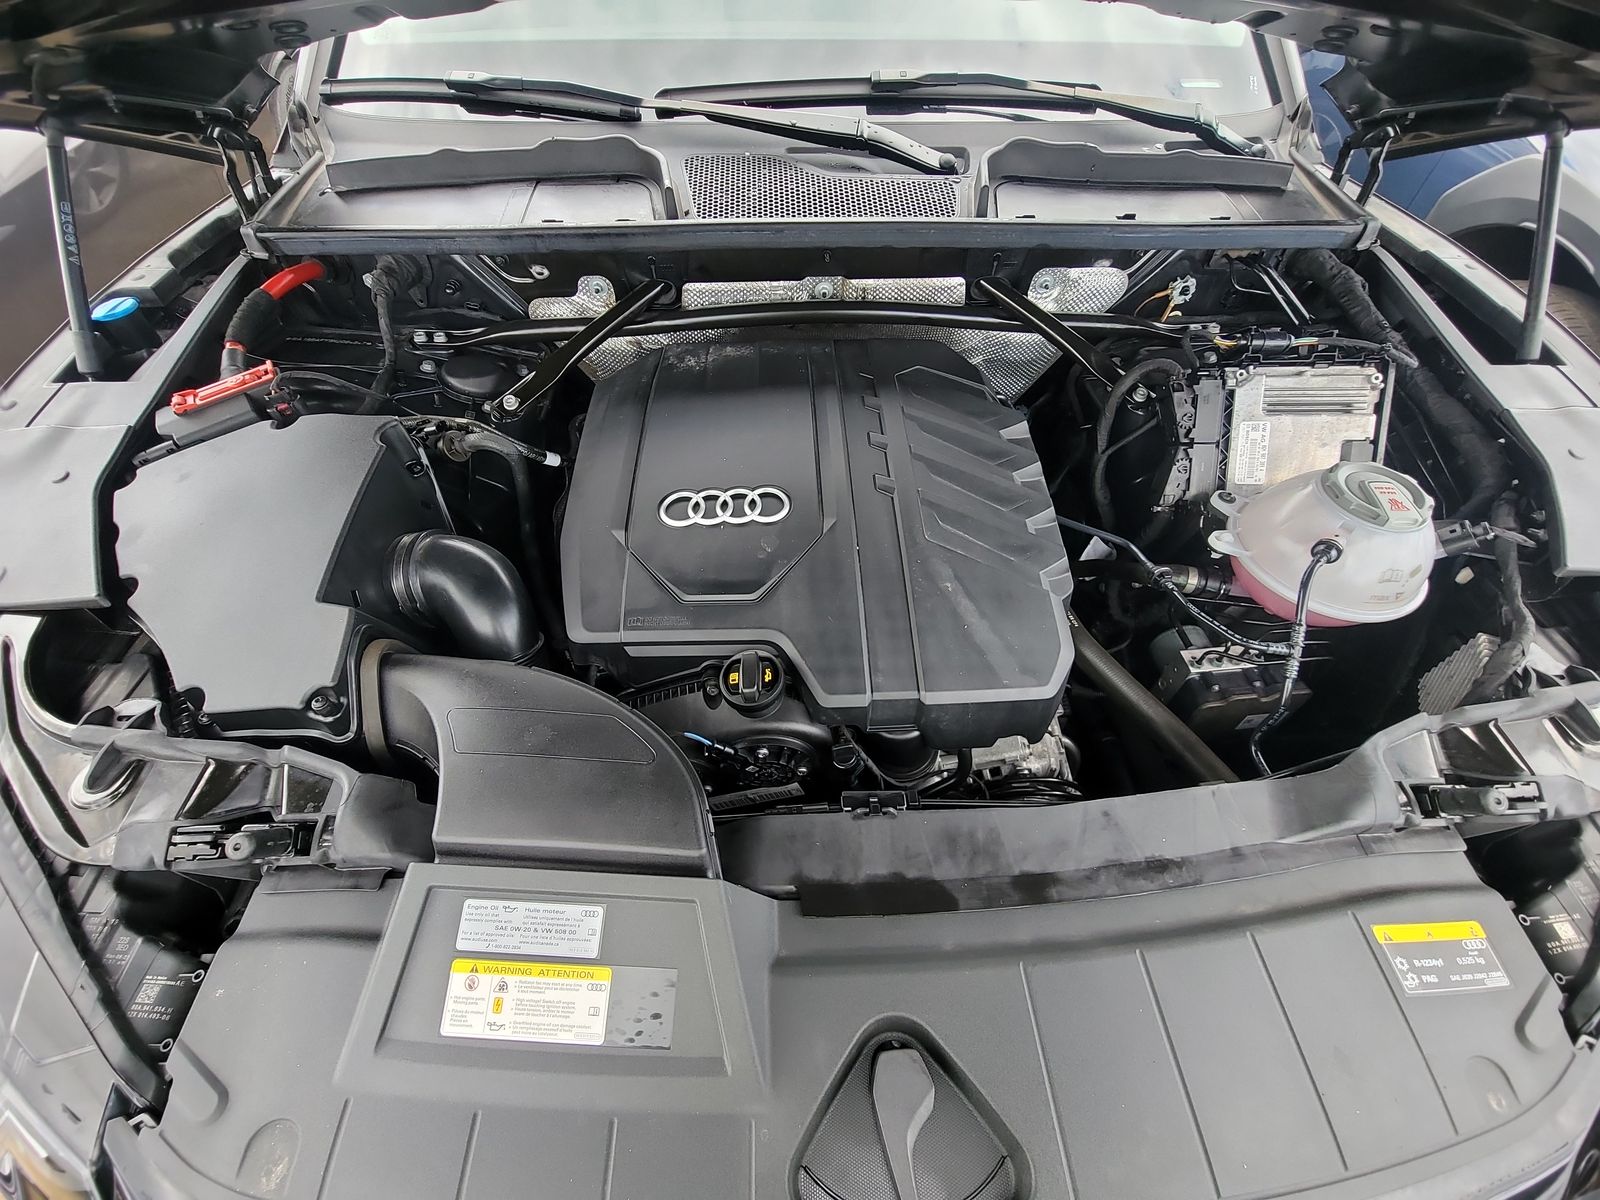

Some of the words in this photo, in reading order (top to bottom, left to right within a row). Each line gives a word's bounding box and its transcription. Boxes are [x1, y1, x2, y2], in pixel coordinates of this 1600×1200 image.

[484, 966, 532, 976] WARNING
[538, 968, 595, 979] ATTENTION
[1420, 974, 1439, 983] PAG
